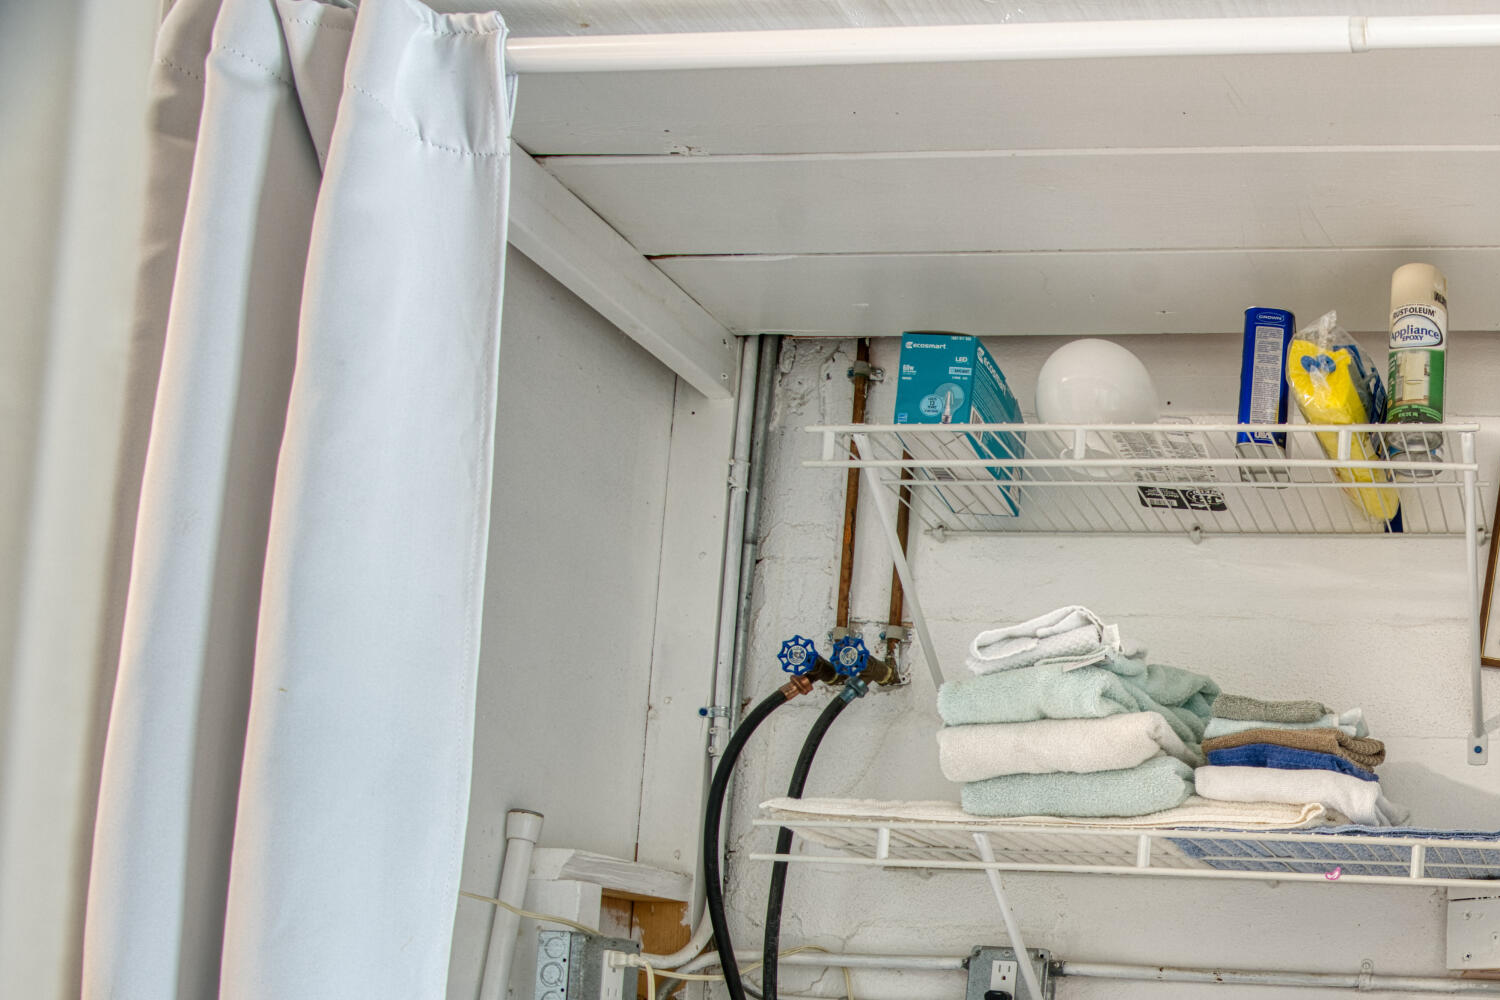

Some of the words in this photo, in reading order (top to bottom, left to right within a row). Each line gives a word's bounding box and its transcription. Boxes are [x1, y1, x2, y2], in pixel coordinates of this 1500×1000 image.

[1257, 313, 1284, 322] CROWN
[1402, 334, 1424, 342] EPOXY
[912, 342, 947, 350] ecosmart
